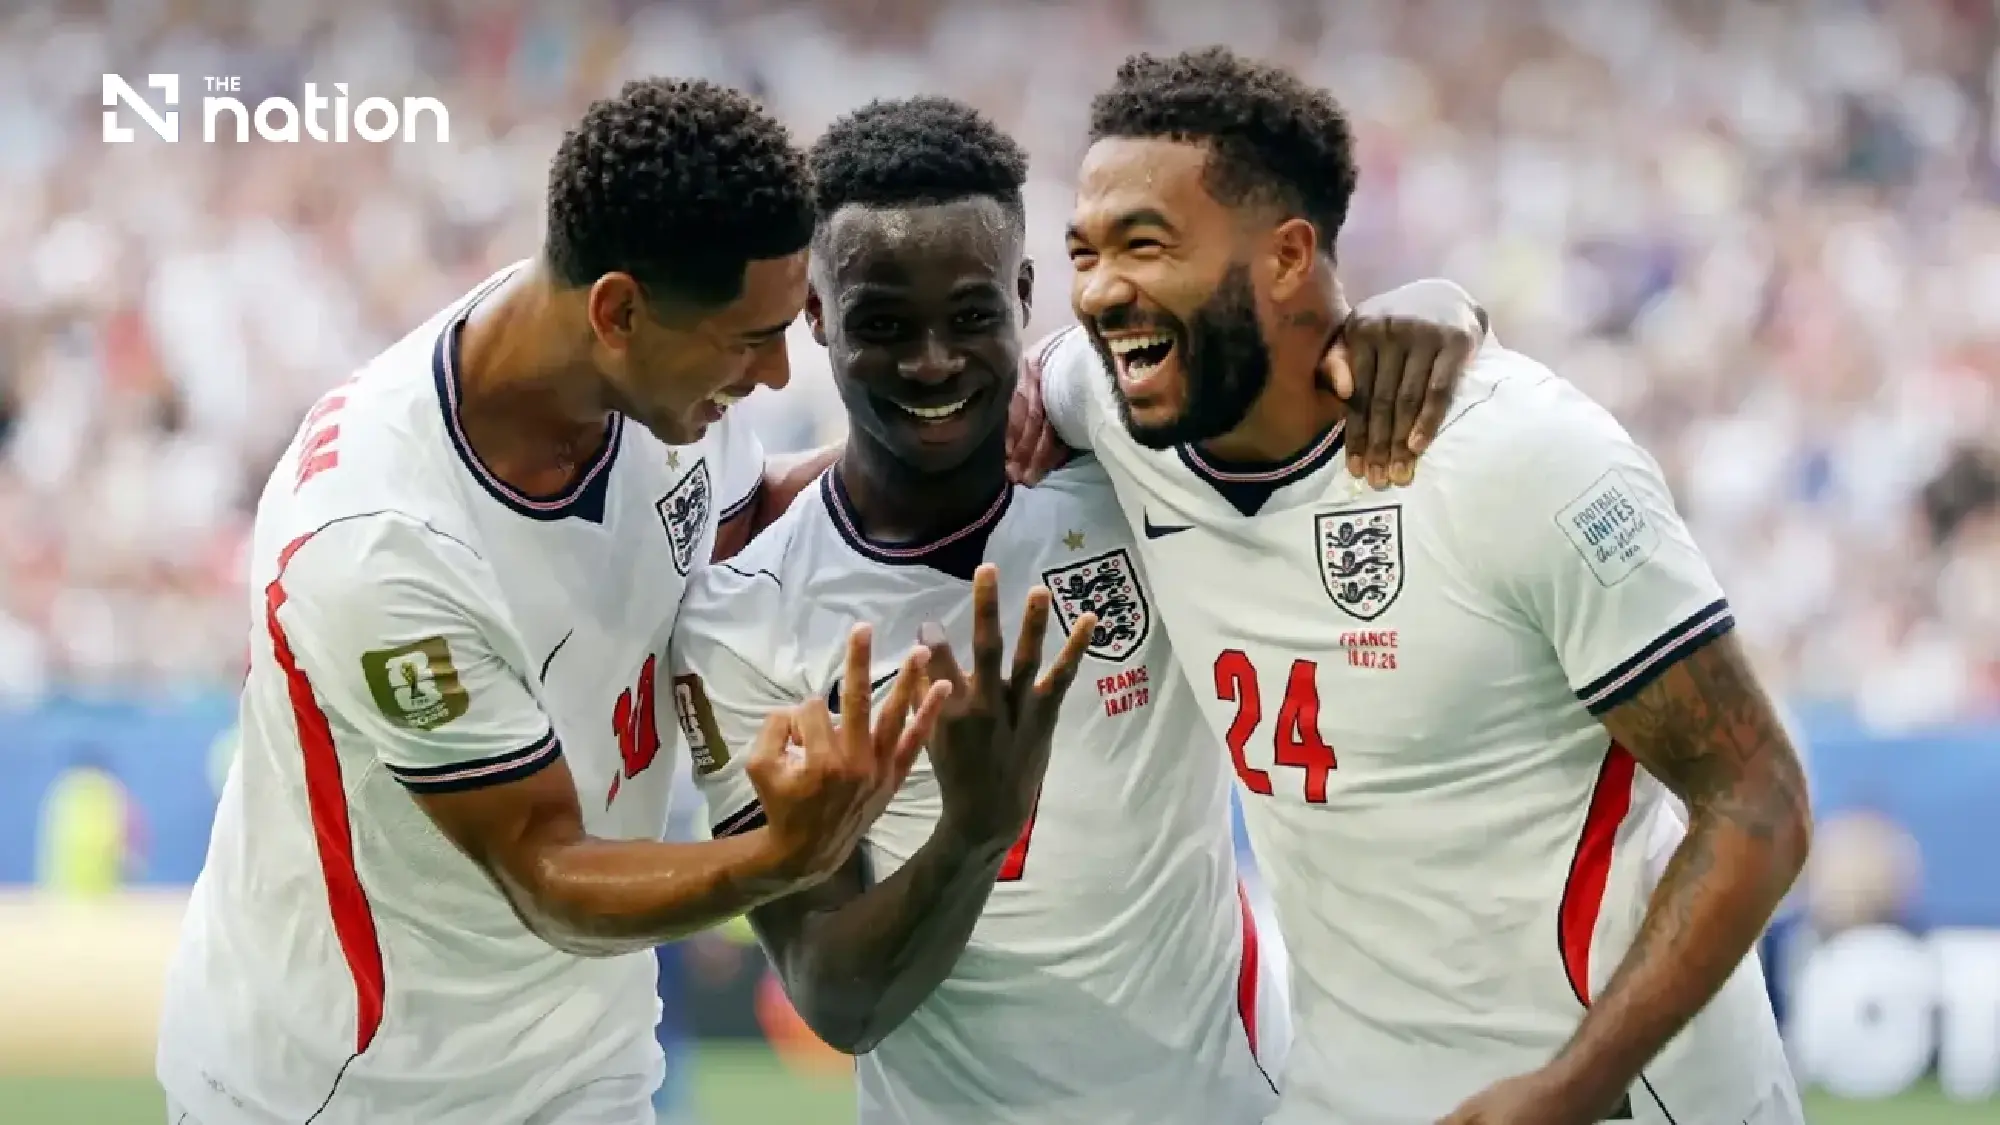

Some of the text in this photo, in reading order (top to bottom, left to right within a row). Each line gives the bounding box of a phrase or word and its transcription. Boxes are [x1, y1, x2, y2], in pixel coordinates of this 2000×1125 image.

[1572, 485, 1623, 529] FOOTBALL
[1582, 498, 1635, 546] UNITES
[1339, 630, 1398, 649] FRANCE
[1214, 648, 1338, 804] 24
